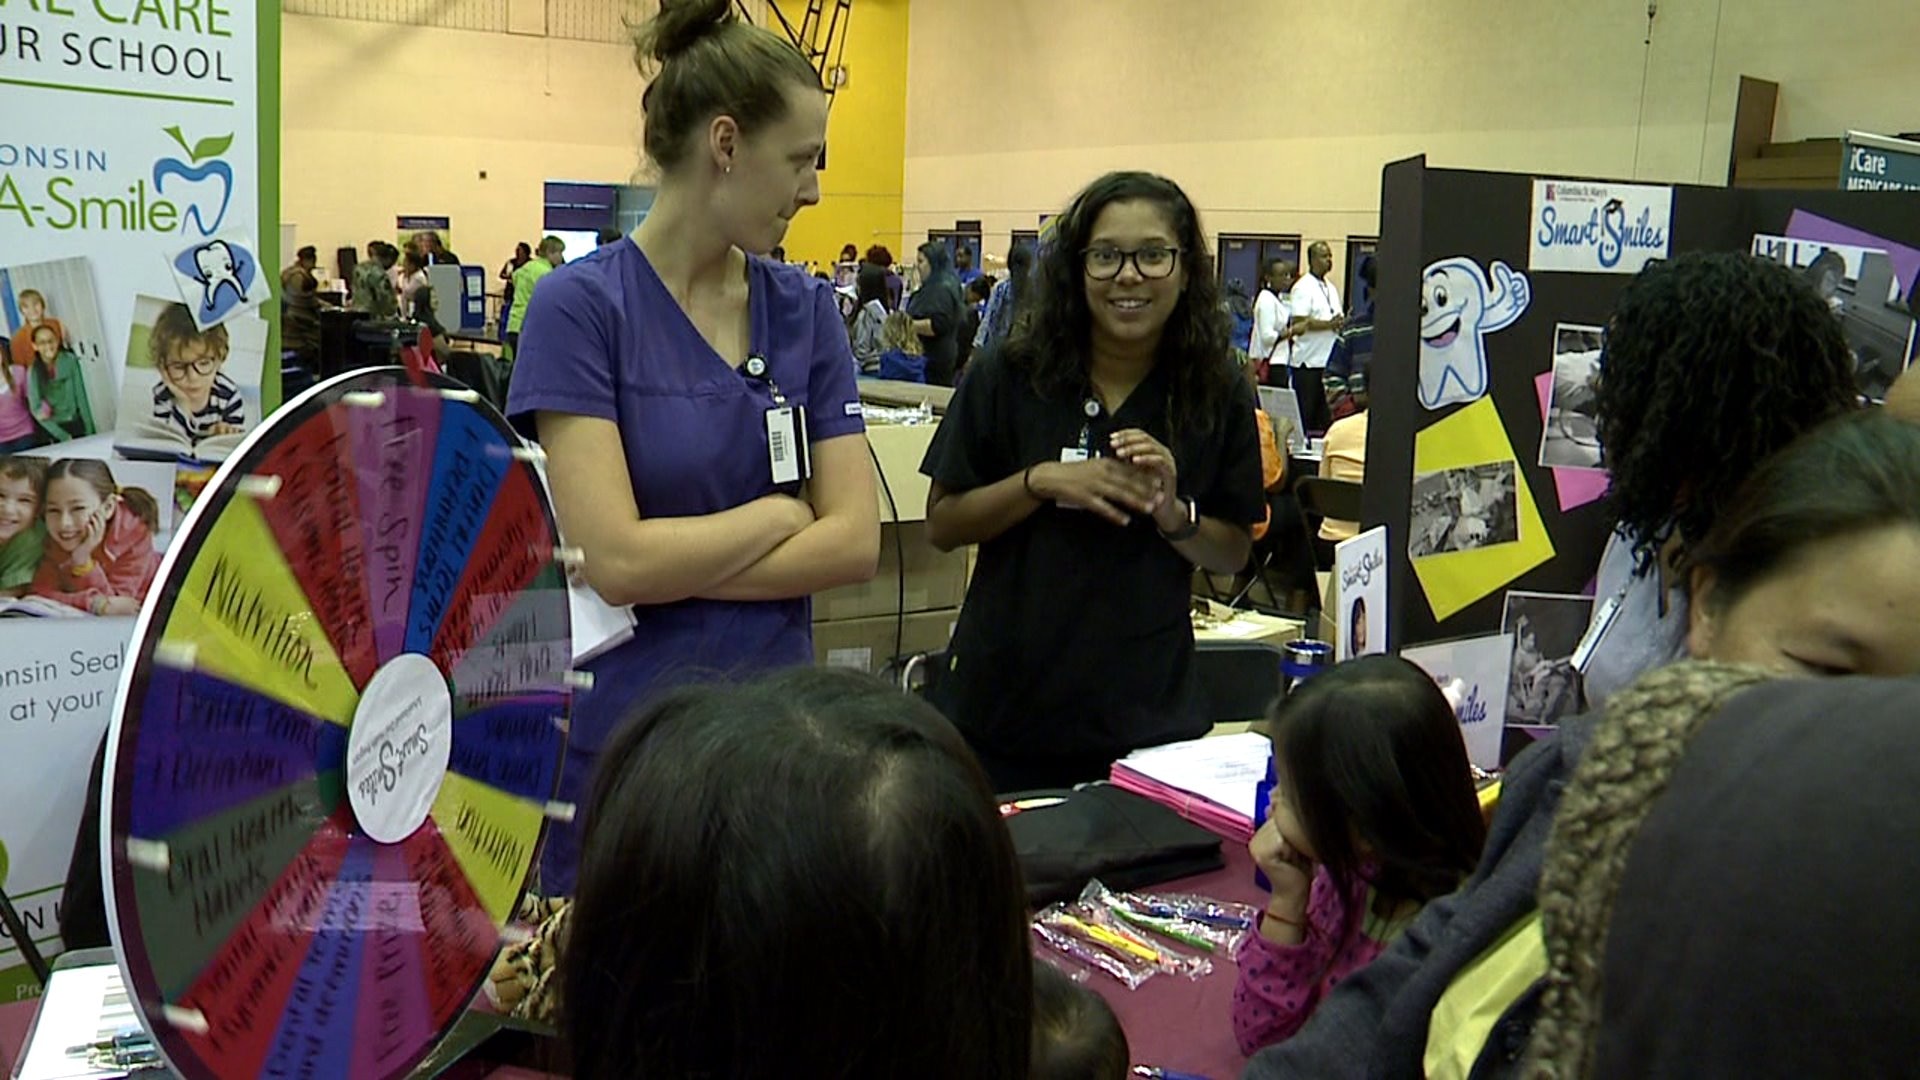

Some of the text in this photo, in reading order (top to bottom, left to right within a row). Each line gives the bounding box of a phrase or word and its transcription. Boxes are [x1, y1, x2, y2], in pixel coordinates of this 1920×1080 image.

[62, 32, 234, 83] SCHOOL
[1850, 146, 1887, 175] iCare
[1538, 205, 1664, 268] Smart Smiles
[373, 513, 410, 614] Spin
[201, 551, 318, 689] Nutrition
[0, 641, 125, 689] nsin Seal
[10, 690, 104, 723] at your
[1456, 683, 1487, 724] miles
[358, 739, 397, 806] Smiles
[396, 722, 429, 779] Smart
